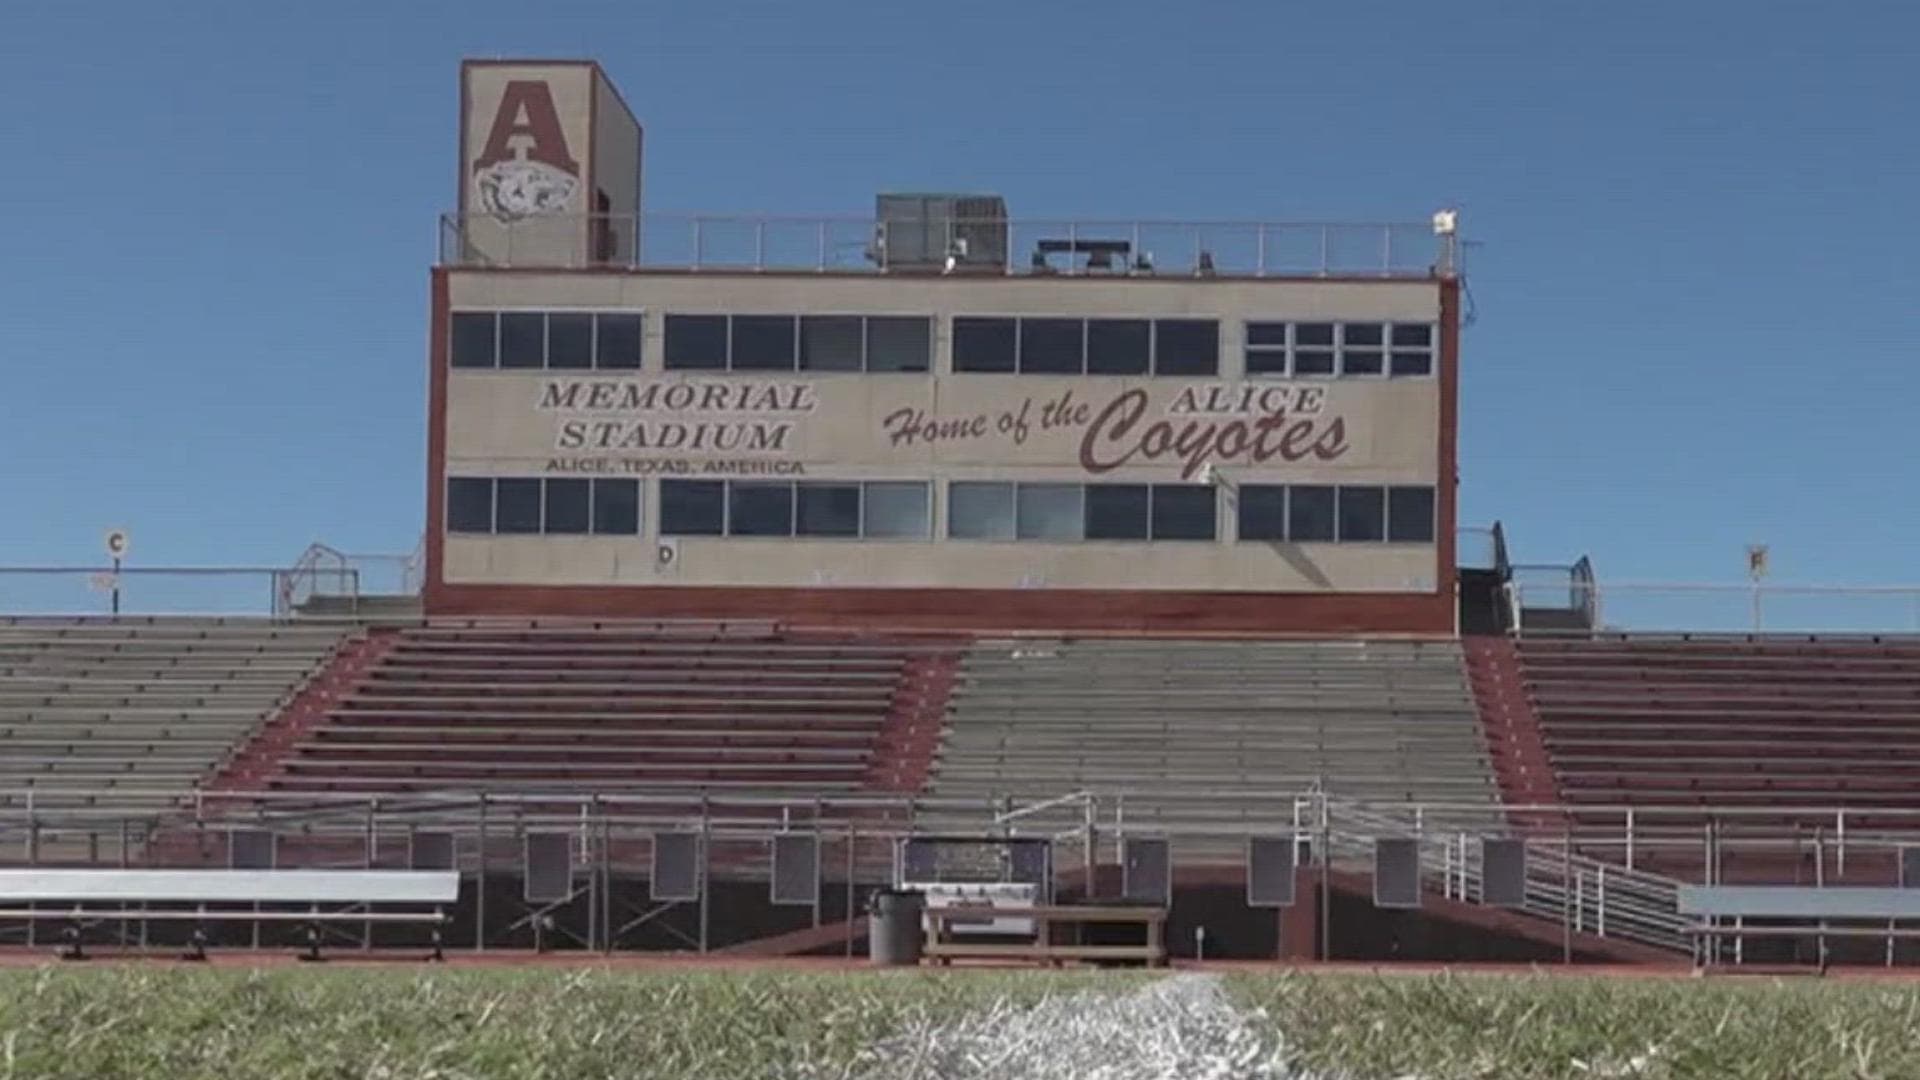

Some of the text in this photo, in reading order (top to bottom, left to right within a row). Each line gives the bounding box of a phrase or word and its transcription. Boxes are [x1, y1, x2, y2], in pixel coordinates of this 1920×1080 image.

[473, 81, 580, 178] A
[540, 382, 815, 411] MEMORIAL
[1170, 386, 1324, 414] ALICE
[884, 389, 1088, 446] Home of the
[559, 421, 792, 450] STADIUM
[1079, 388, 1350, 481] Coyotes
[703, 458, 806, 475] AMERICA
[109, 532, 124, 553] C
[659, 545, 674, 565] D
